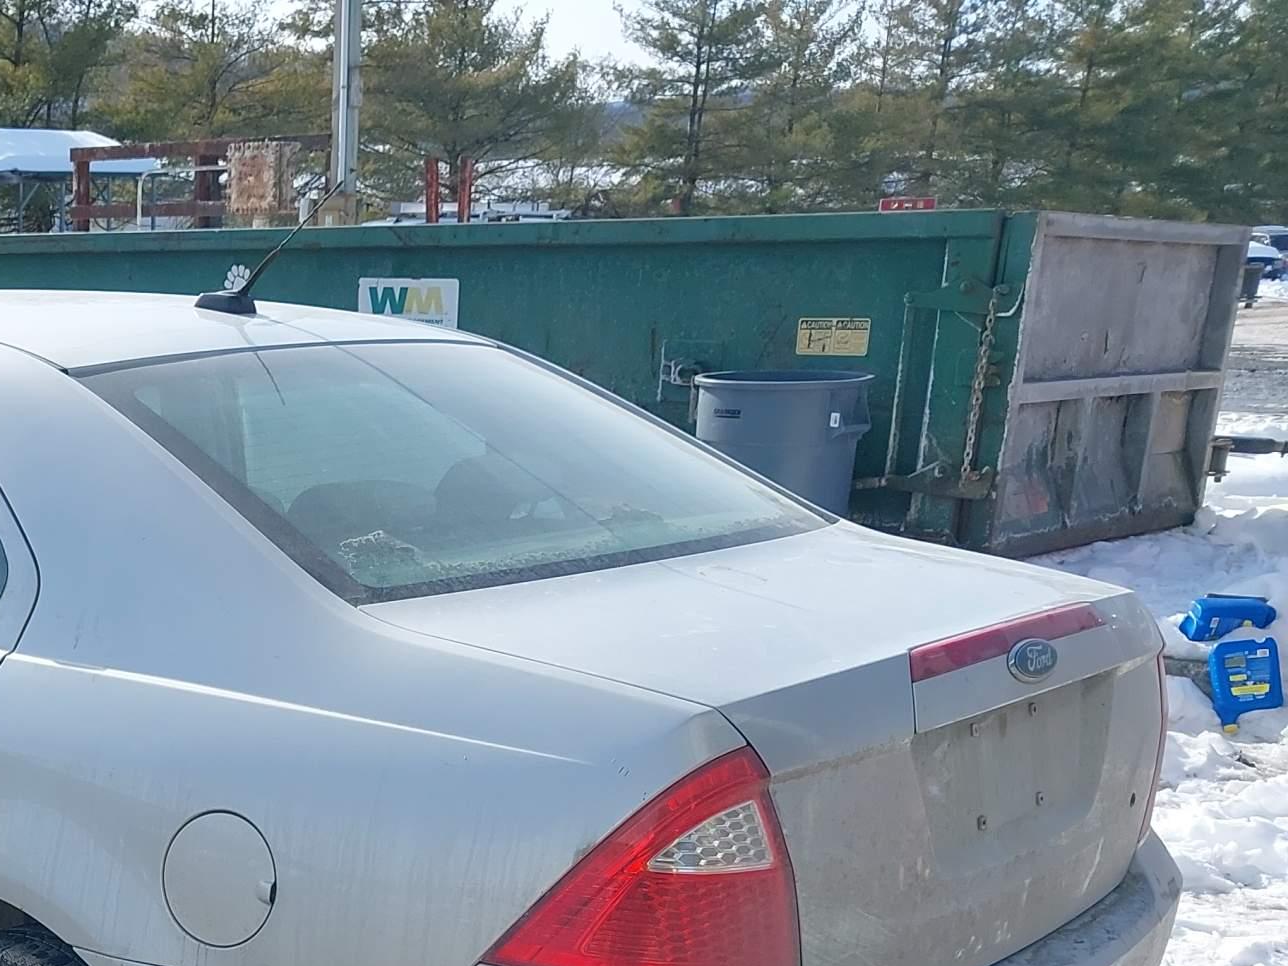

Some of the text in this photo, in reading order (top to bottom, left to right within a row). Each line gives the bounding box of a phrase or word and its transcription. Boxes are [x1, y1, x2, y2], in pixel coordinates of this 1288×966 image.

[368, 286, 444, 315] WM
[807, 321, 832, 330] CAUTION
[842, 321, 868, 330] CAUTION
[1026, 644, 1052, 672] Ford
